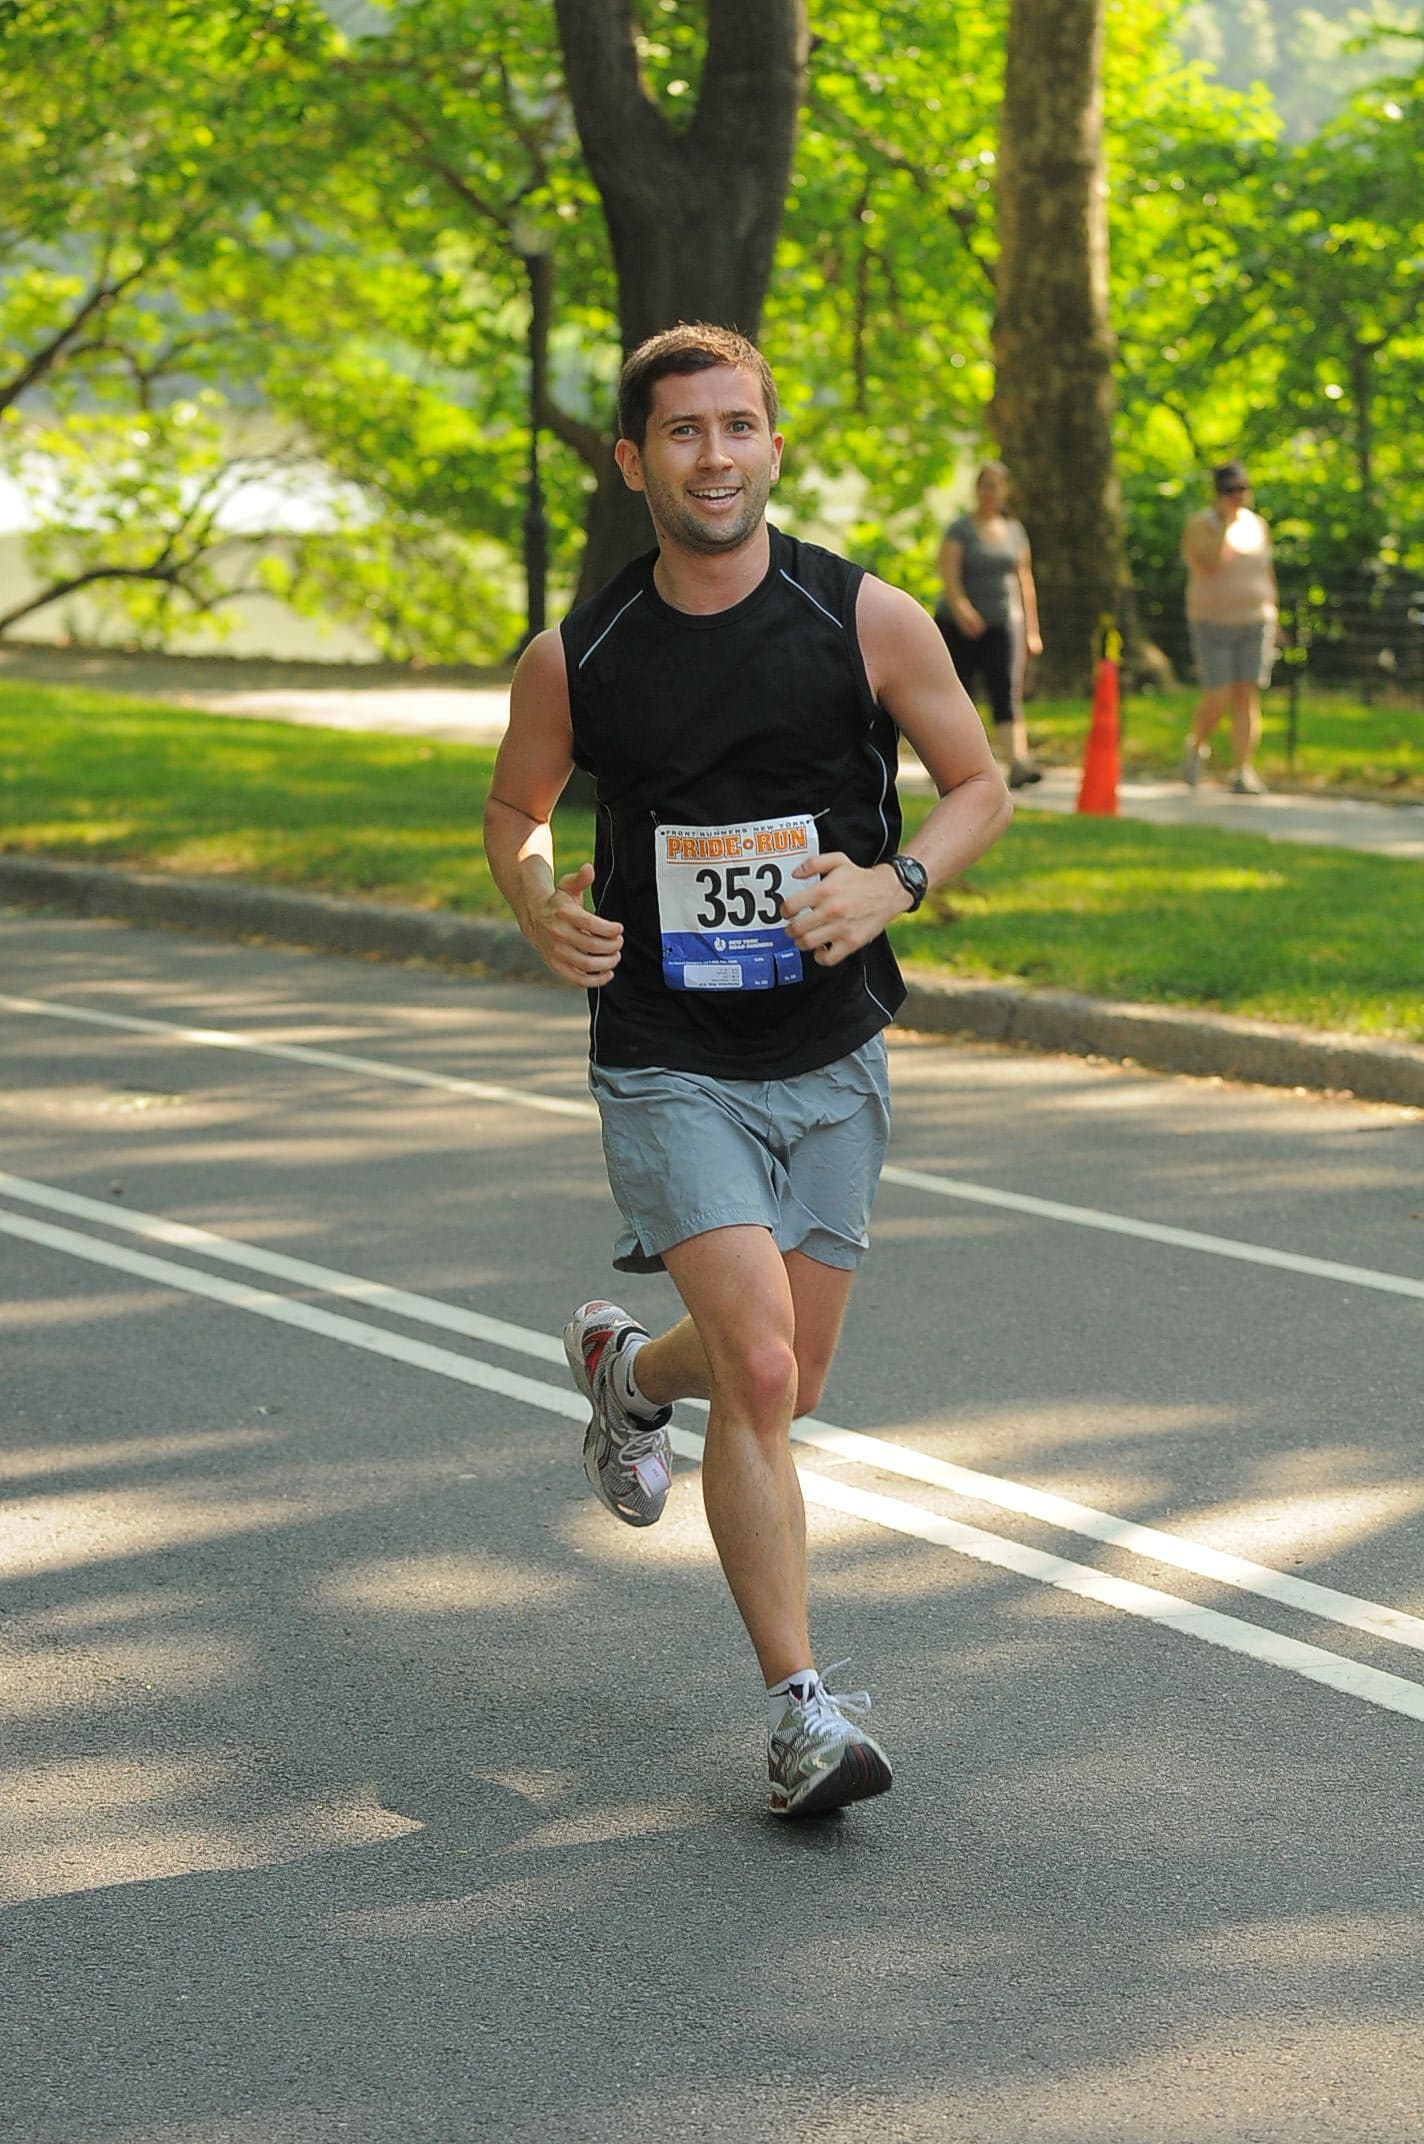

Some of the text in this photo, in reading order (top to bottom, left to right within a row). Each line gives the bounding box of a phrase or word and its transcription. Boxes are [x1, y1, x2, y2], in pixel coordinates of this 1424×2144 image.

[667, 827, 807, 860] PRIDE RUN
[700, 828, 748, 837] RUNNERS
[696, 864, 785, 928] 353
